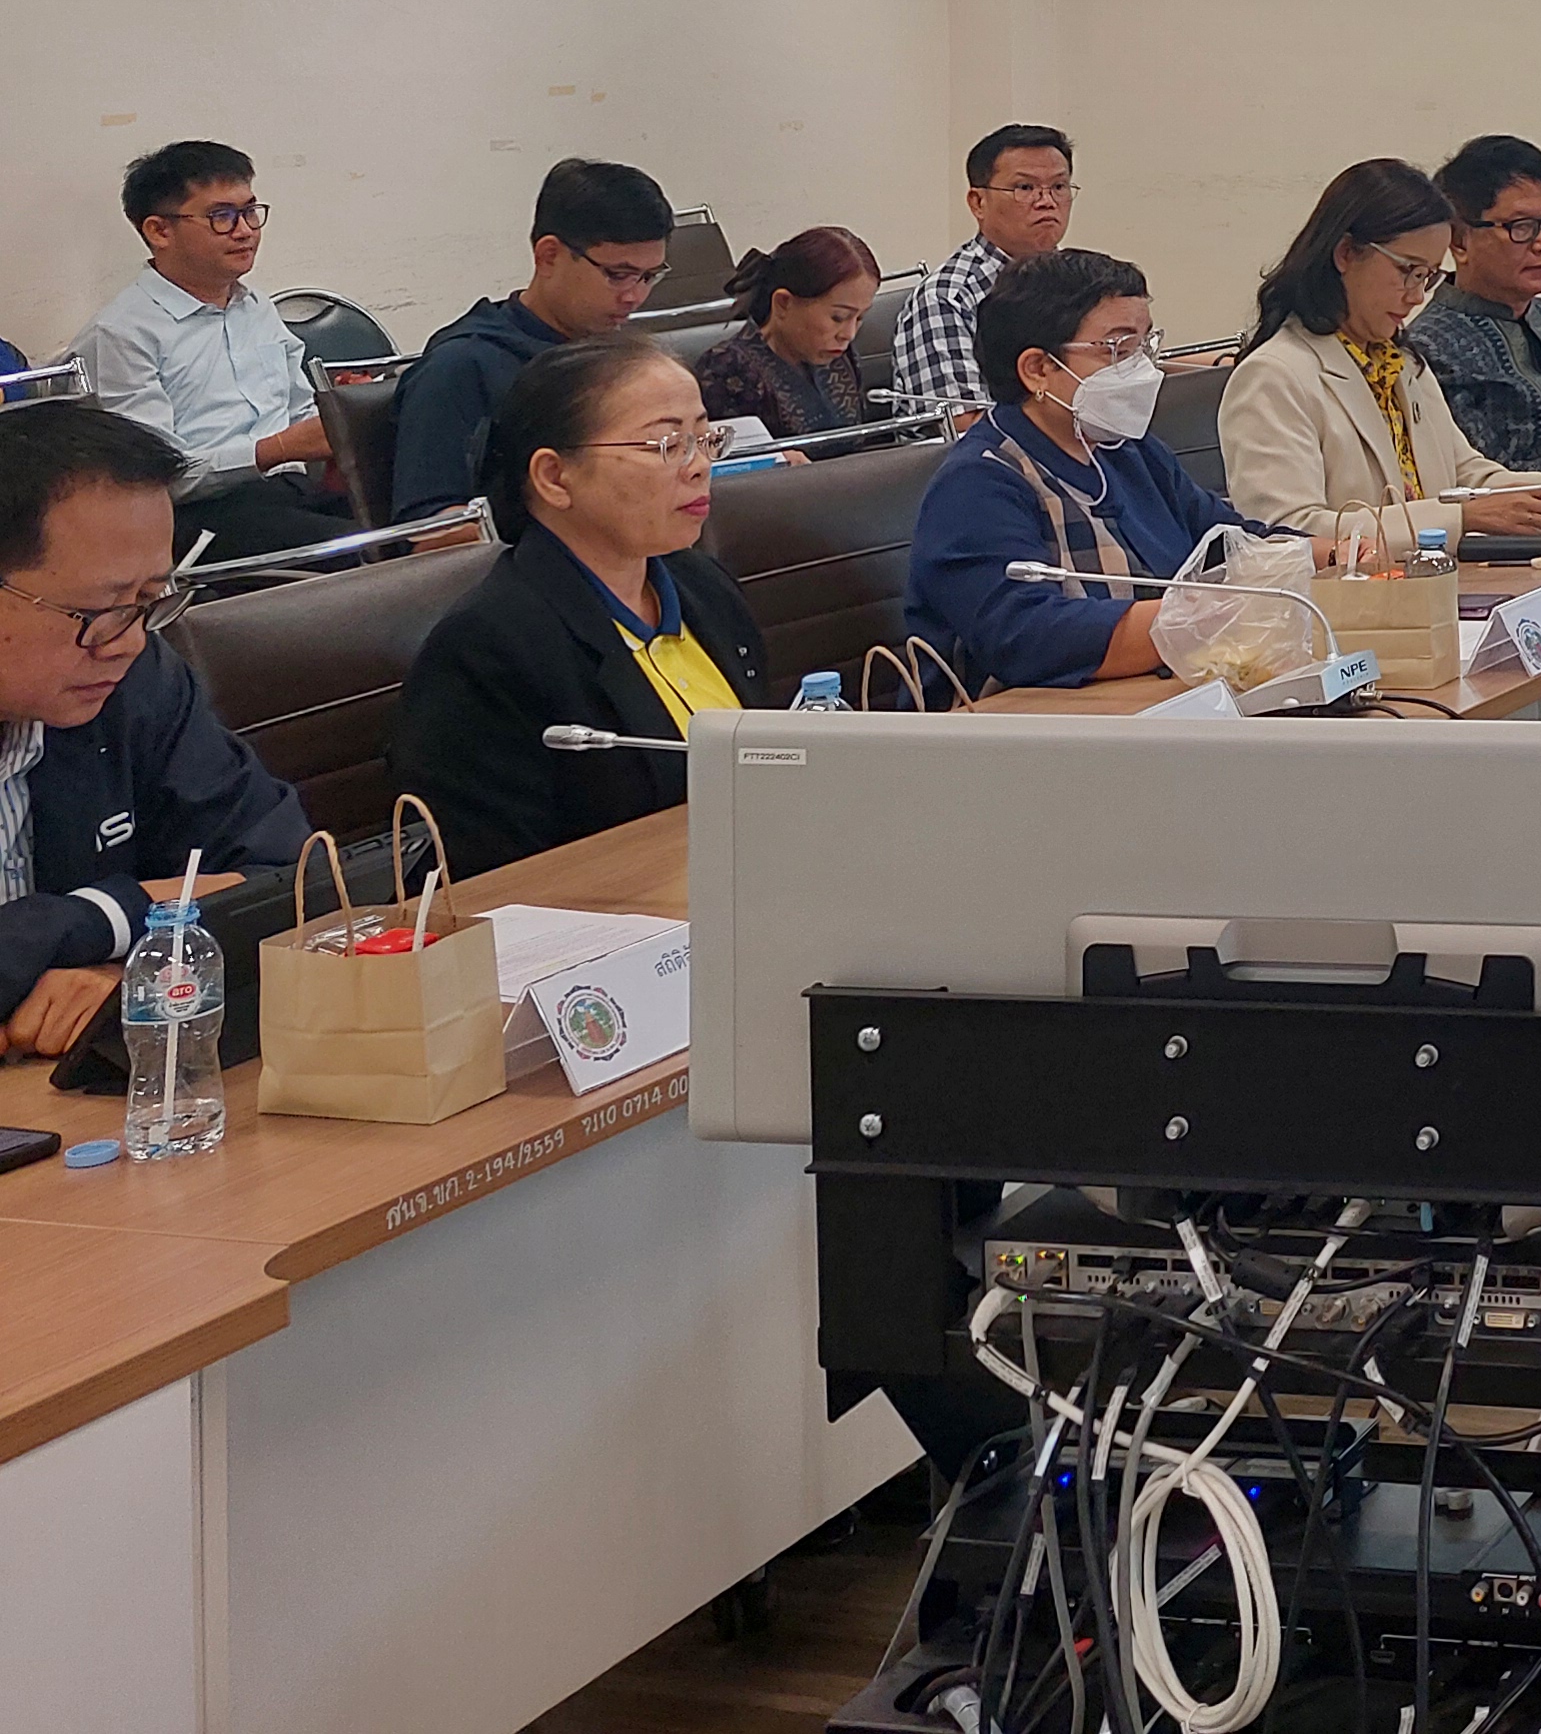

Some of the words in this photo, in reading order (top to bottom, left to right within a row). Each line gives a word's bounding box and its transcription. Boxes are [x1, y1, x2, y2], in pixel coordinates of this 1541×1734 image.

[1340, 659, 1368, 681] NPE
[171, 985, 194, 997] aro
[465, 1129, 566, 1192] 2-194/2559
[622, 1086, 664, 1118] 0714
